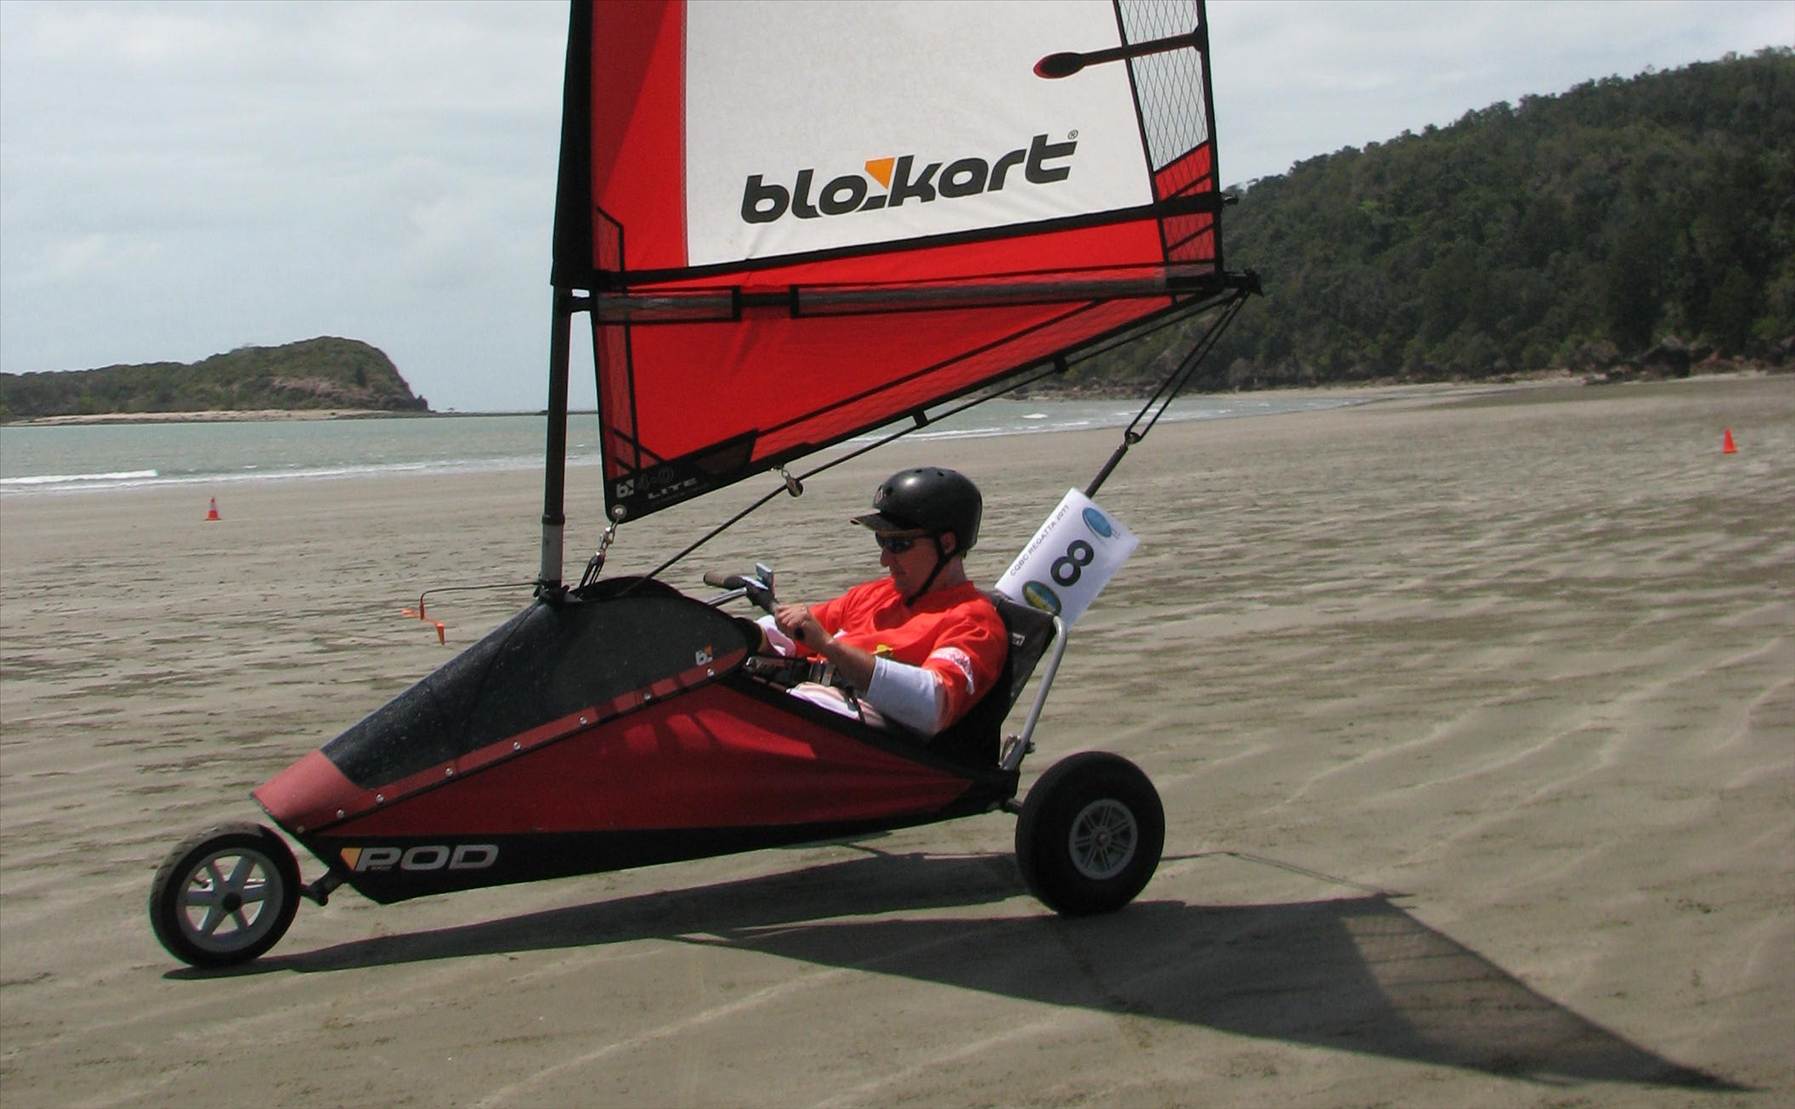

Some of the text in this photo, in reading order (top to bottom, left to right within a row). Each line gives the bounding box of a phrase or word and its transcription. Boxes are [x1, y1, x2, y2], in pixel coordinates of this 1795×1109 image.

[648, 477, 697, 499] LITE
[1028, 521, 1056, 554] REGATTA
[1050, 539, 1094, 587] 8
[355, 844, 499, 872] POD
